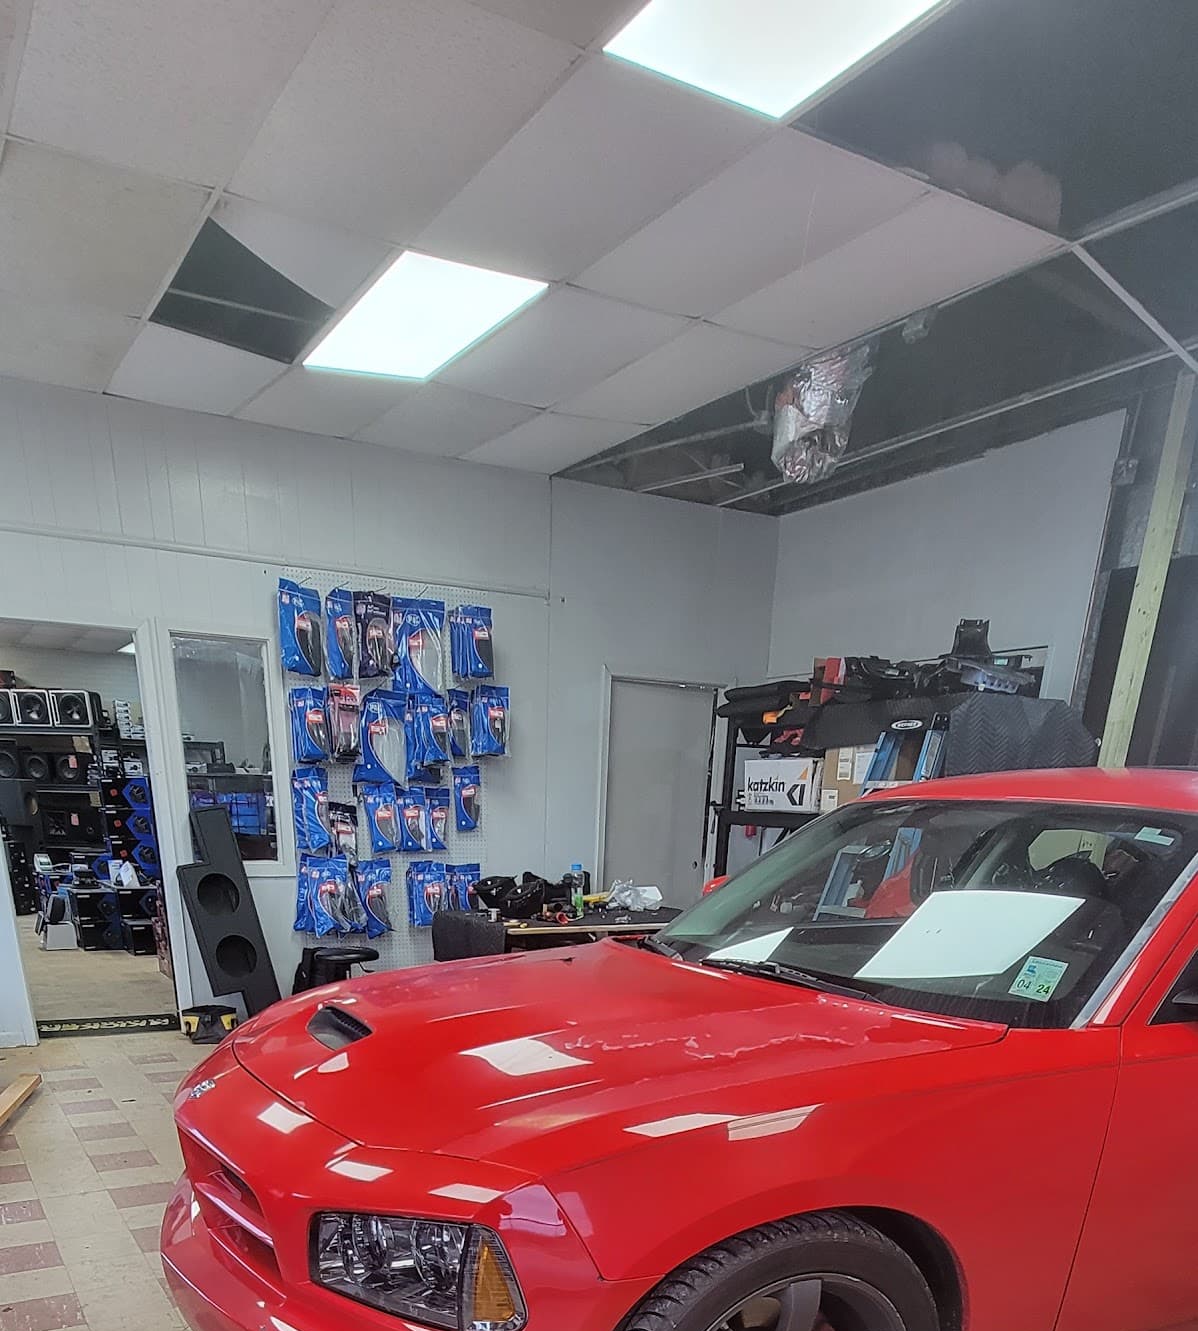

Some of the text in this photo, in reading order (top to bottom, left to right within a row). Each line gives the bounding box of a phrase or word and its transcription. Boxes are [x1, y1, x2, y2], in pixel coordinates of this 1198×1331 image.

[747, 776, 785, 792] katzkin
[1016, 979, 1051, 995] 04 24
